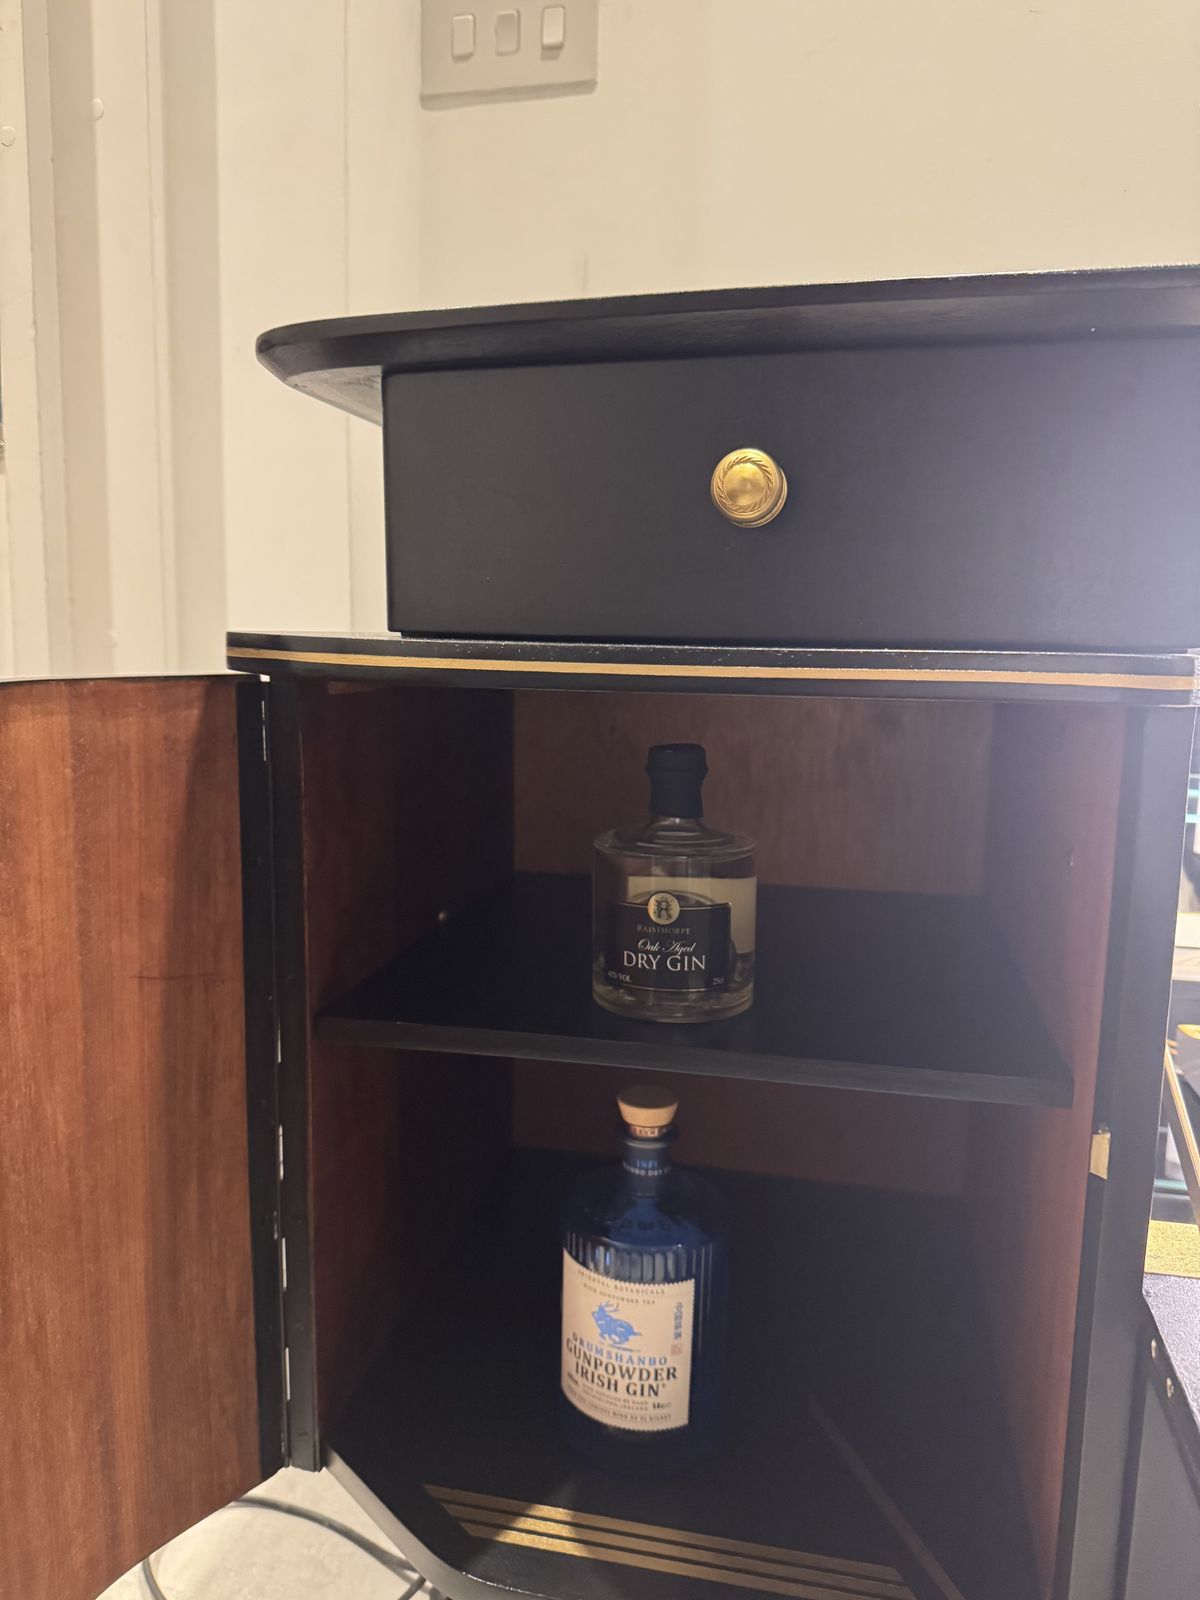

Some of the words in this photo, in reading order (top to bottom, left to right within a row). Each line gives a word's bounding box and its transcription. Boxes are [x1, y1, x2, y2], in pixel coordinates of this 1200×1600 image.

[623, 950, 661, 970] DRY
[666, 954, 706, 971] GIN
[637, 938, 660, 952] Oak
[661, 940, 697, 957] Aged
[614, 1285, 666, 1295] BOTANICALS
[566, 1338, 678, 1382] GUNPOWDER
[572, 1332, 668, 1366] DRUMSHANBO
[575, 1361, 619, 1393] IRISH
